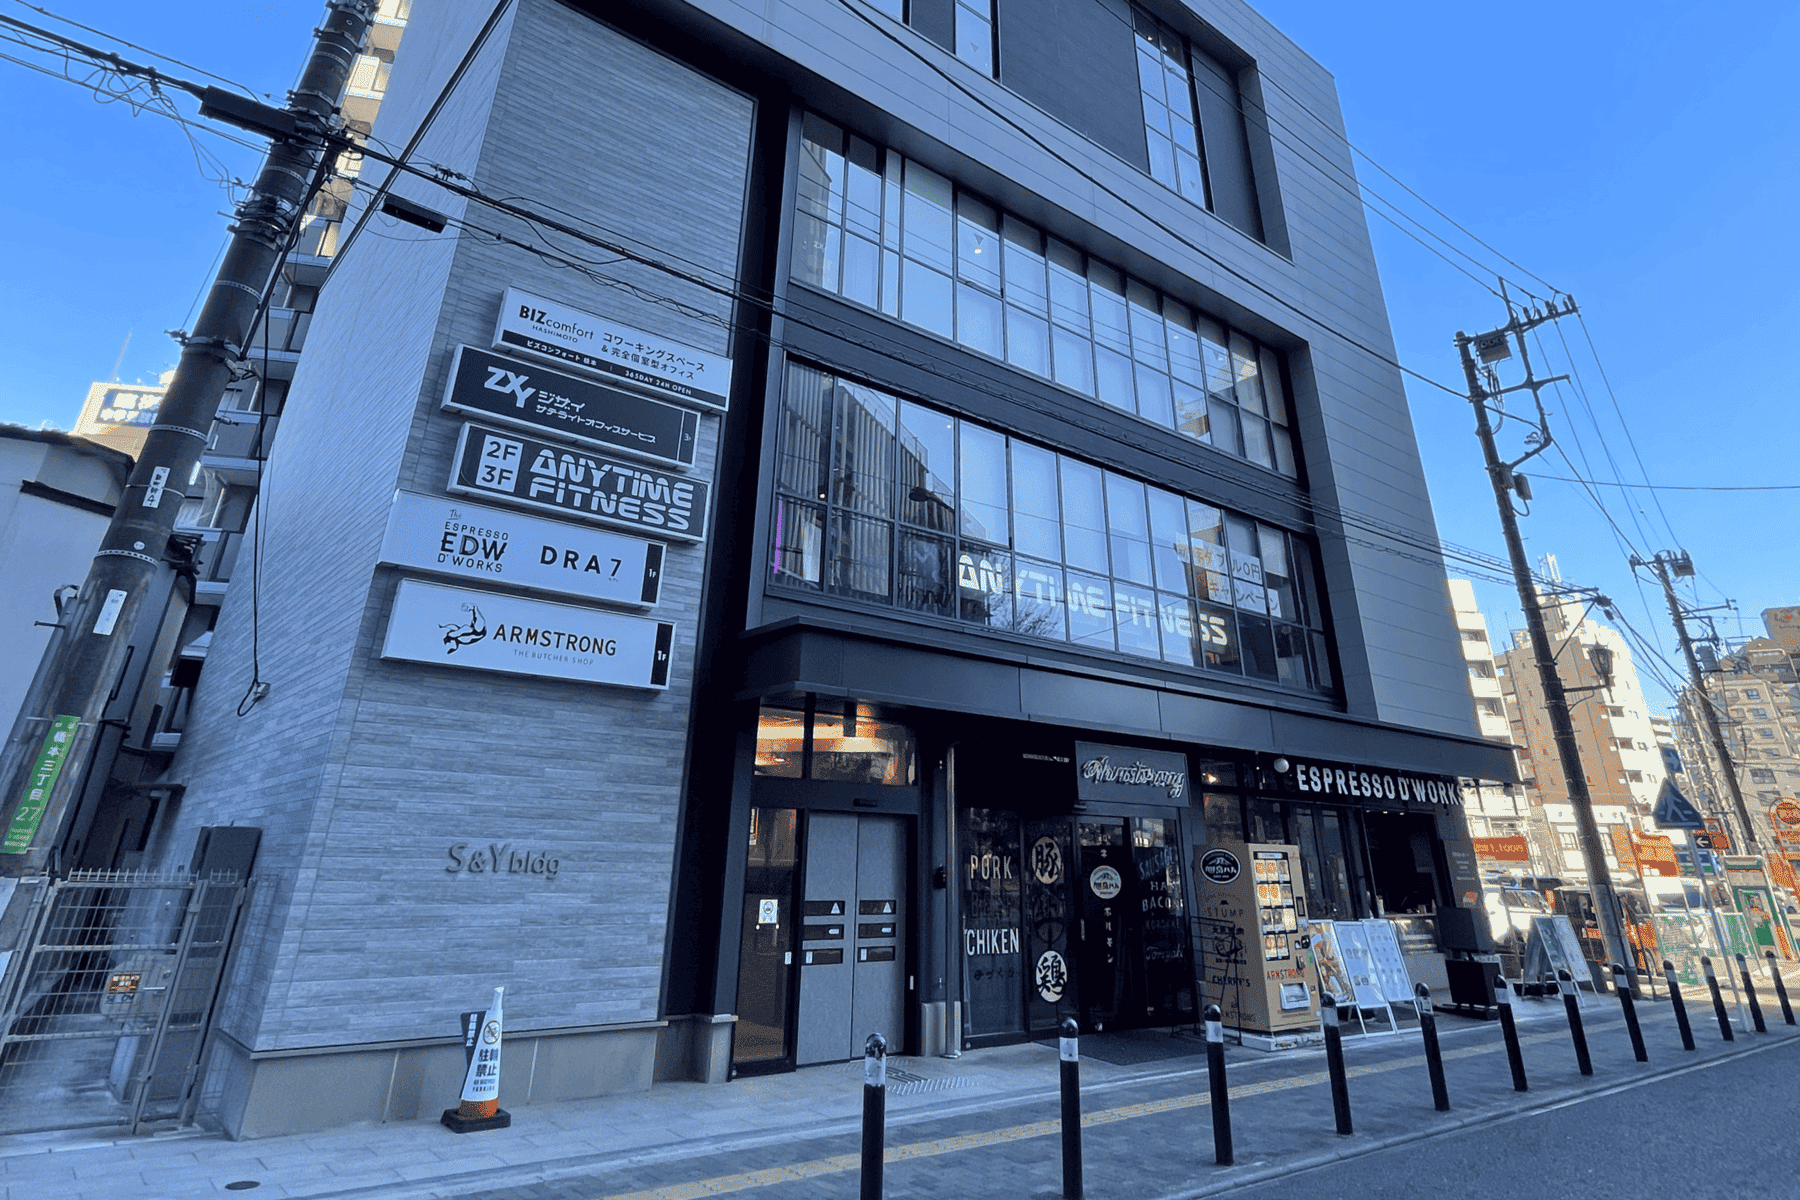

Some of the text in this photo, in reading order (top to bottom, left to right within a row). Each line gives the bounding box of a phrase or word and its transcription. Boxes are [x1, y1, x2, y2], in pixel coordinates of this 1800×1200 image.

[532, 325, 578, 343] HASHIMOTO
[603, 332, 705, 372] コワーキングスペース
[625, 370, 654, 384] 365DAY
[672, 384, 692, 396] OPEN
[537, 390, 585, 413] ジザイ
[535, 404, 656, 444] サテライトオフィスサービス
[486, 441, 519, 461] 2F
[481, 465, 514, 486] 3F
[529, 449, 694, 508] ANYTIME
[529, 477, 691, 530] FITNESS
[445, 521, 509, 541] ESPRESSO
[440, 531, 508, 561] EDW
[493, 624, 617, 656] ARMSTRONG
[514, 649, 594, 666] THE BUTCHER SHOP
[657, 650, 667, 662] 1F
[1296, 764, 1396, 799] ESPRESSO
[970, 854, 1012, 880] PORK
[966, 927, 1020, 956] CHIKEN
